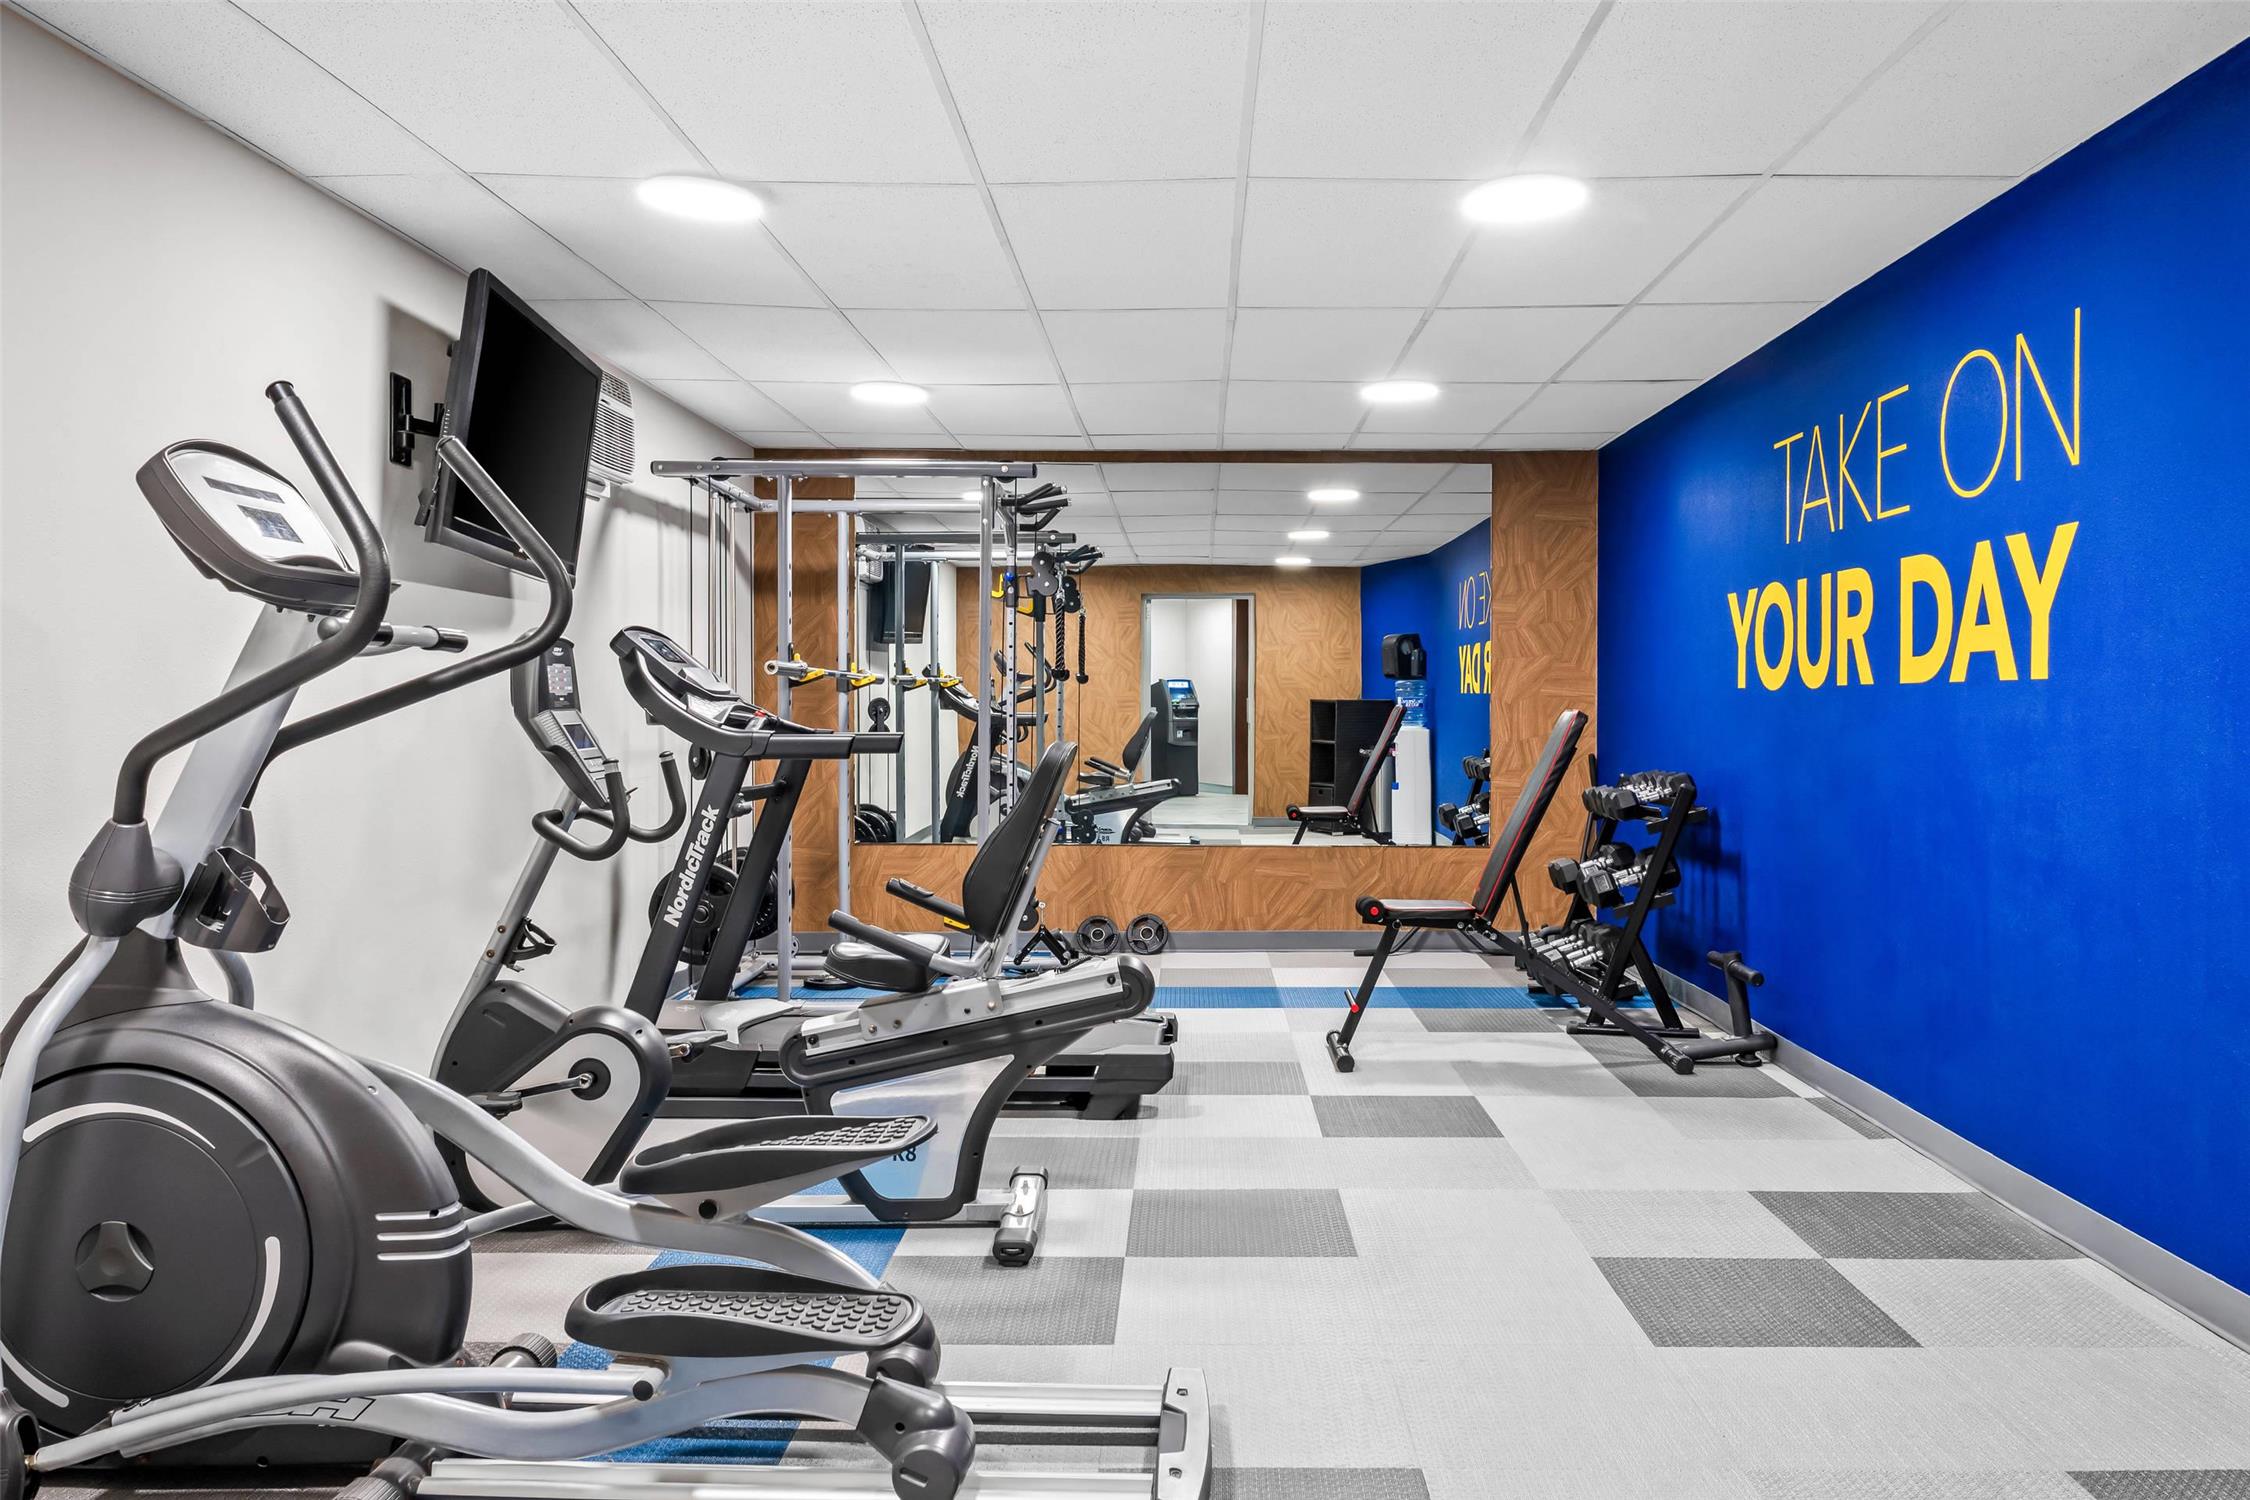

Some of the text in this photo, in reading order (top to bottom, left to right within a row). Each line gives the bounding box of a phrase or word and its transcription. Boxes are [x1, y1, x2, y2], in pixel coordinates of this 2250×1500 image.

[1773, 307, 2081, 545] TAKE ON
[1727, 521, 2080, 691] YOUR DAY
[663, 804, 720, 928] NordicTrack
